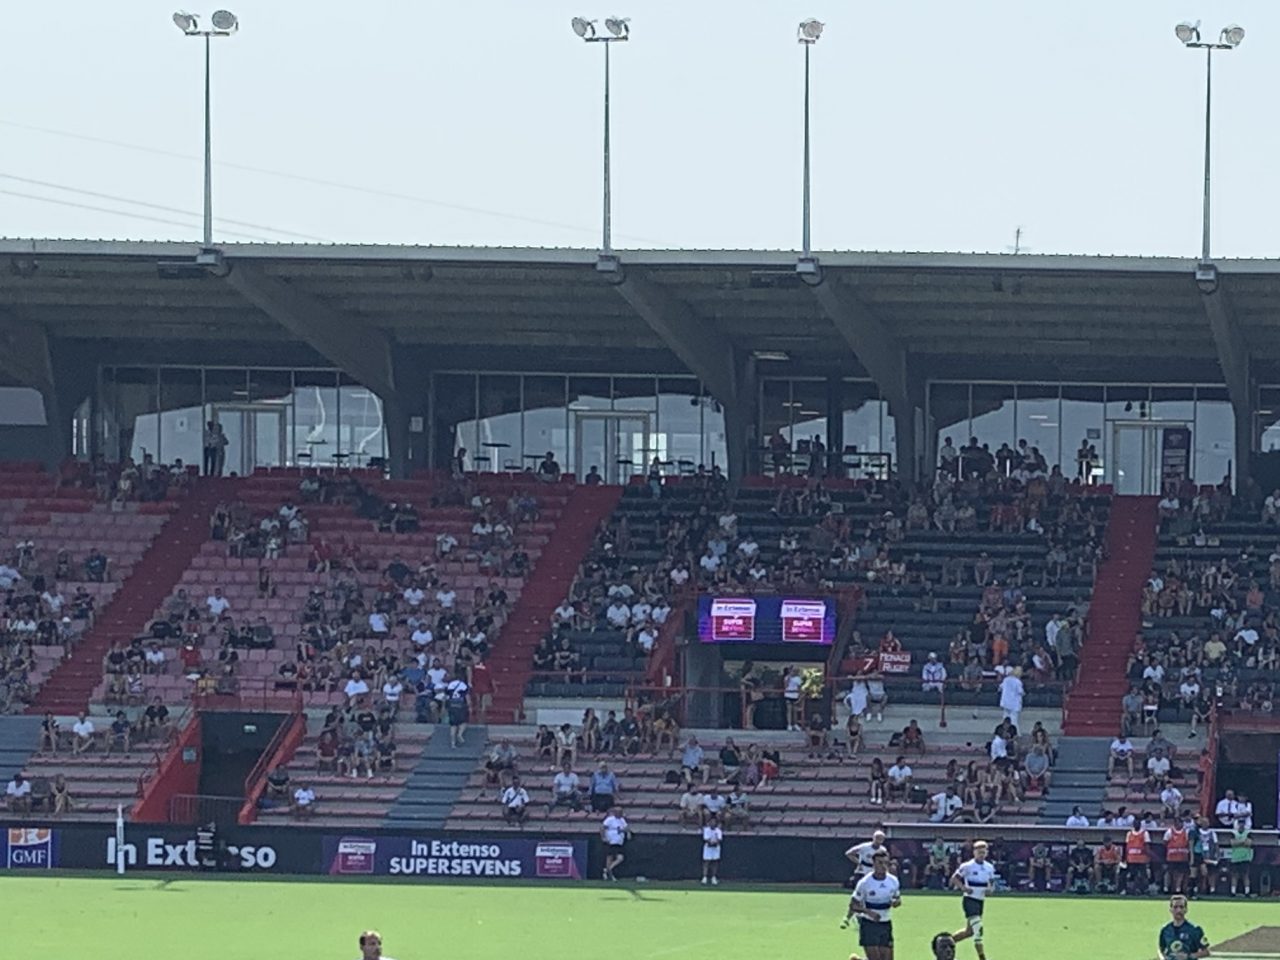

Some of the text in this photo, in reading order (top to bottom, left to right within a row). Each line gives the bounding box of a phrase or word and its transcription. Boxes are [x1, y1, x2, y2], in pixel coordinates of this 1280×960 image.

[863, 658, 874, 670] 7
[12, 850, 47, 865] GMF
[106, 837, 137, 865] In
[411, 840, 501, 858] In Extenso
[390, 857, 522, 876] SUPERSEVENS
